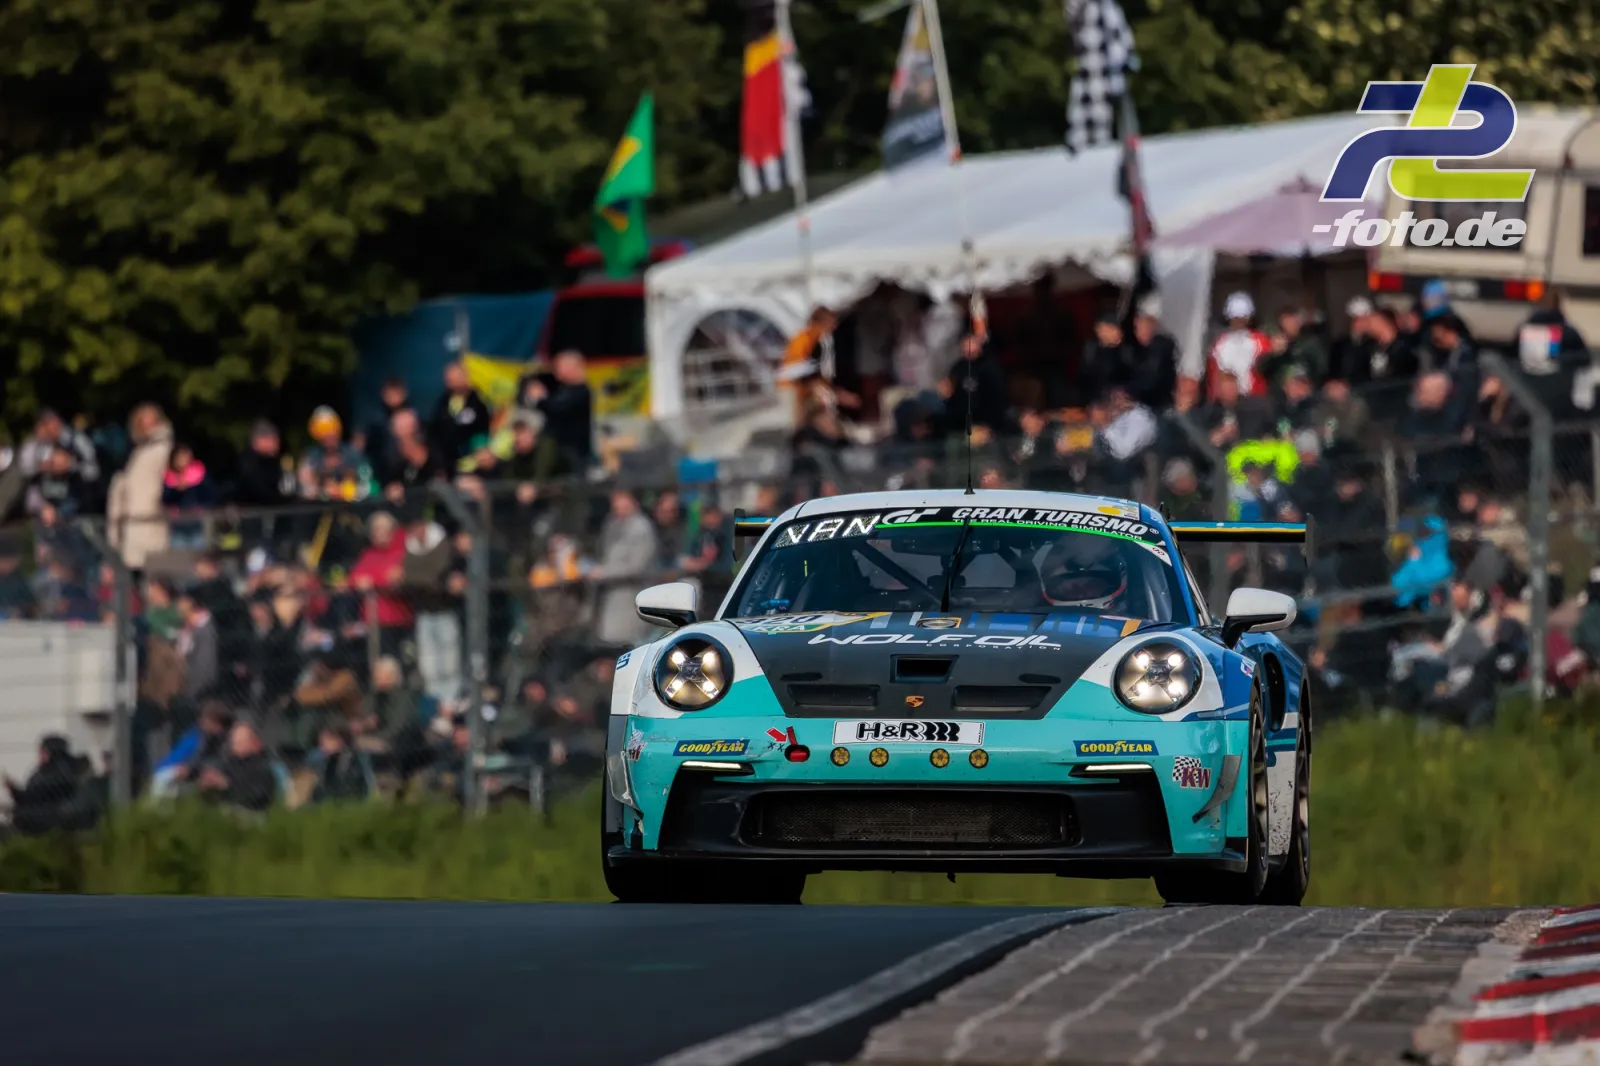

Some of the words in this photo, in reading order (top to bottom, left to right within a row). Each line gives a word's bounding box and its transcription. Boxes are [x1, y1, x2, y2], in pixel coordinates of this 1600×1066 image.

[787, 514, 881, 544] VAN
[952, 507, 1029, 520] GRAN
[1033, 509, 1148, 535] TURISMO
[1016, 519, 1067, 528] DRIVING
[1070, 523, 1142, 541] SIMULATOR
[808, 633, 1062, 648] WOLFOIL
[926, 643, 1061, 651] CORPORATION
[857, 721, 925, 742] H&R
[678, 740, 744, 754] GOODYEAR
[1080, 741, 1153, 754] GOODYEAR
[1180, 766, 1212, 788] KW
